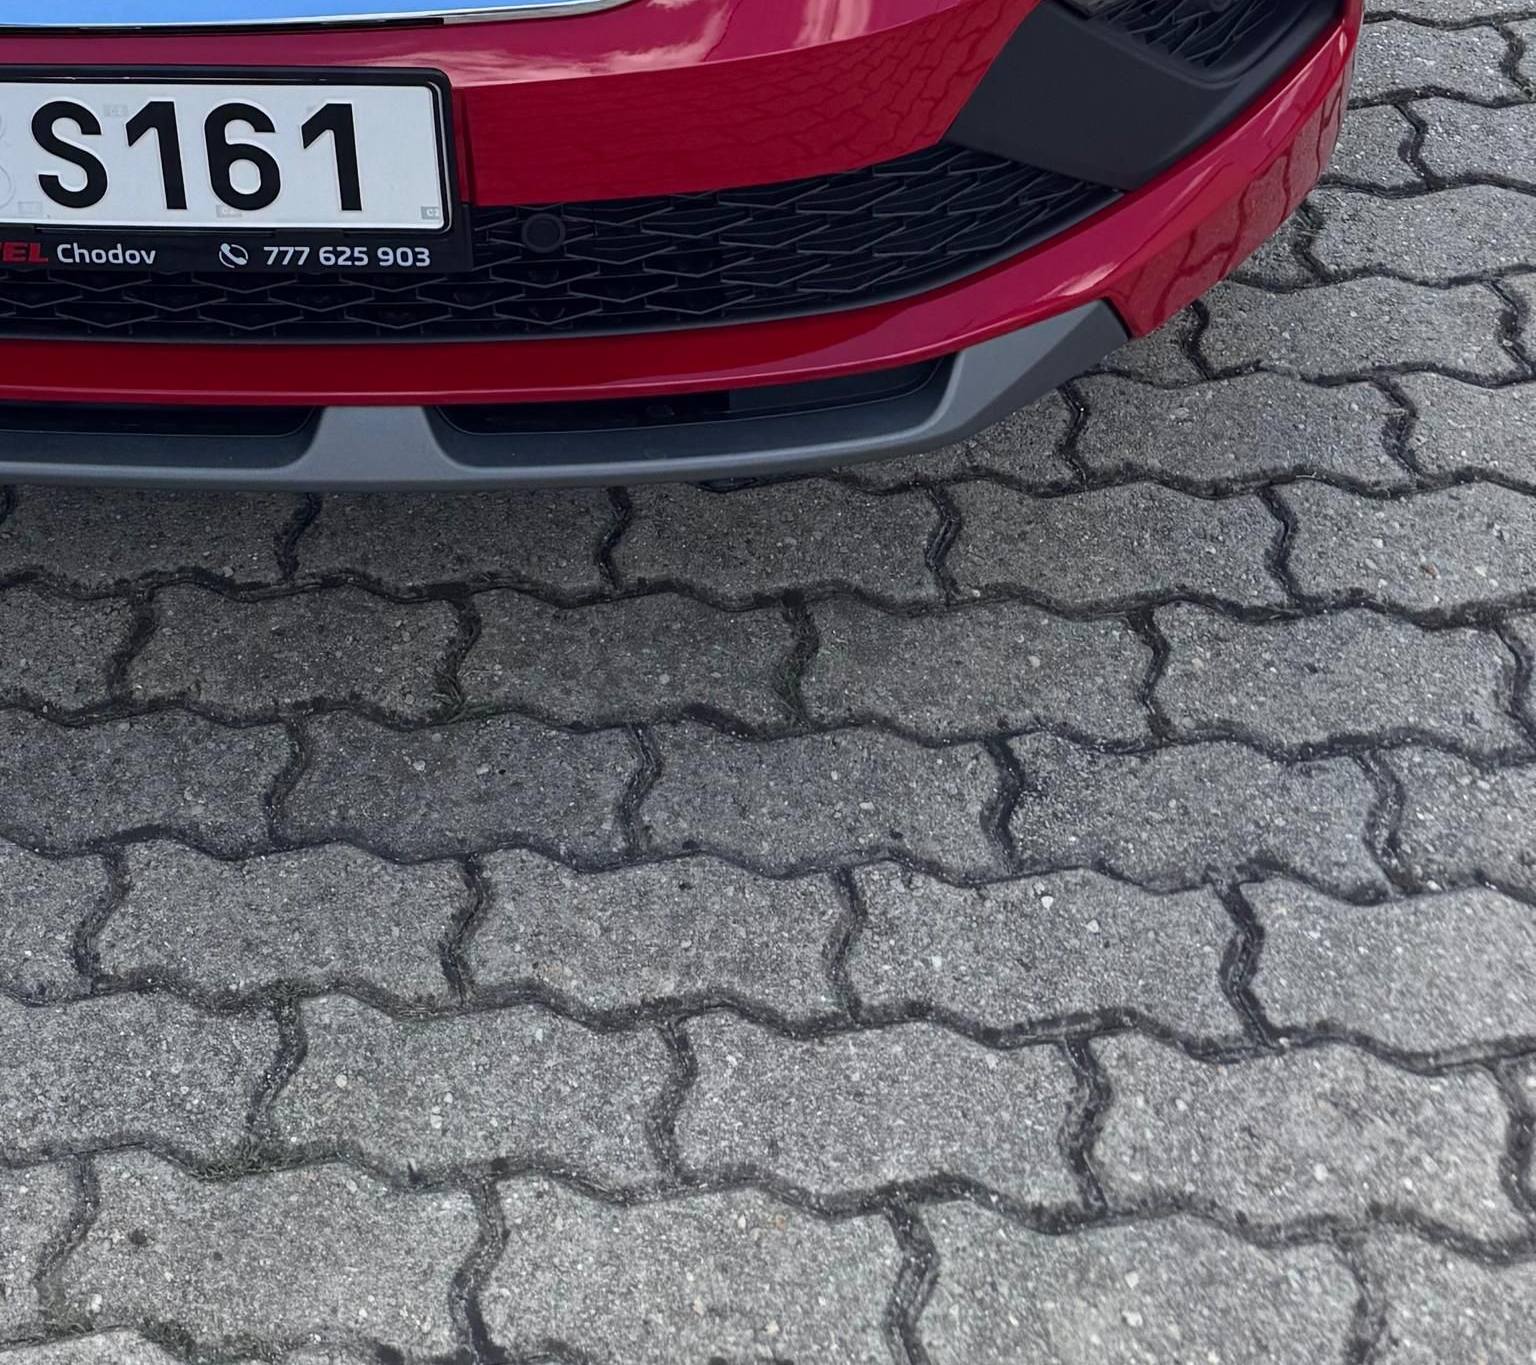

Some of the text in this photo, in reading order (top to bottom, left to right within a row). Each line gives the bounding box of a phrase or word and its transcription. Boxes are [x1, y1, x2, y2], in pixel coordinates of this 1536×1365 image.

[31, 101, 362, 211] S161
[56, 243, 157, 264] Chodov
[264, 246, 431, 267] 777 625 903
